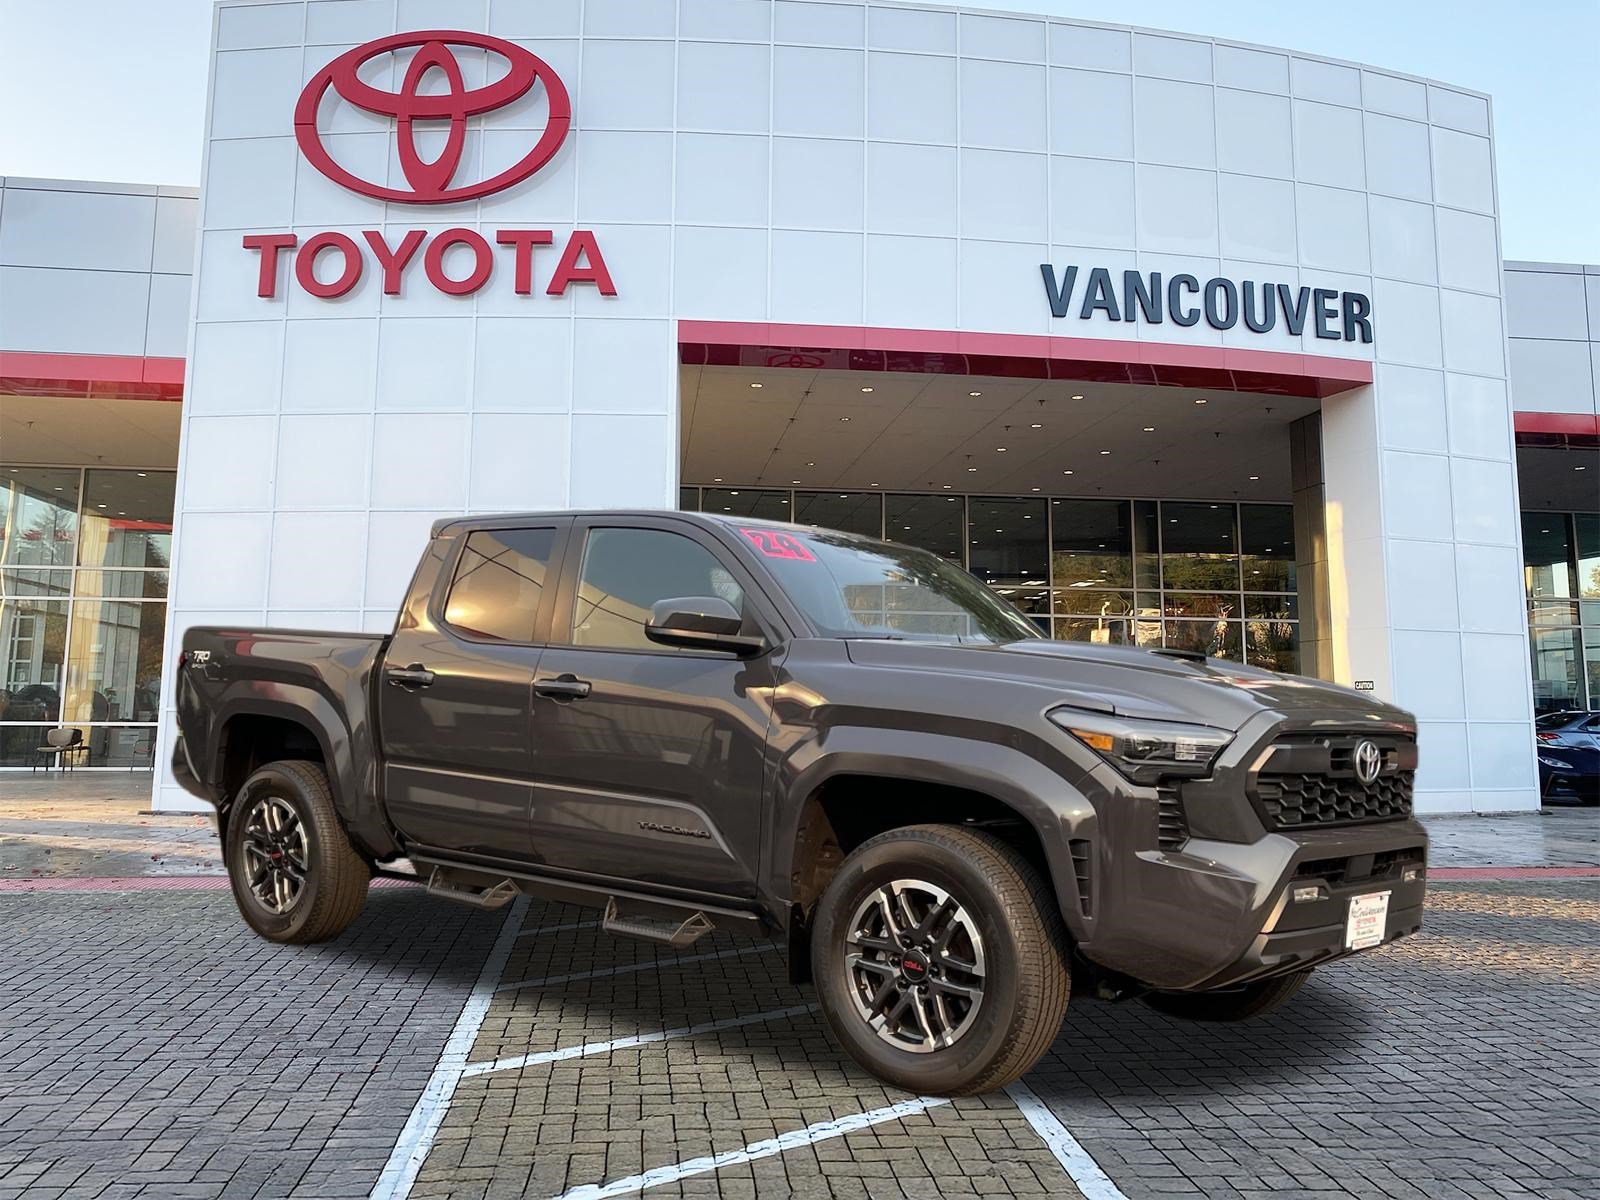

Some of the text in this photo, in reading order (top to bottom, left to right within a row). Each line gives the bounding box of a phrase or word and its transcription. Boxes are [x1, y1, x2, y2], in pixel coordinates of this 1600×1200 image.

[242, 228, 618, 299] TOYOTA
[1040, 264, 1373, 344] VANCOUVER
[193, 650, 210, 663] TRD
[638, 821, 712, 839] TACOMA
